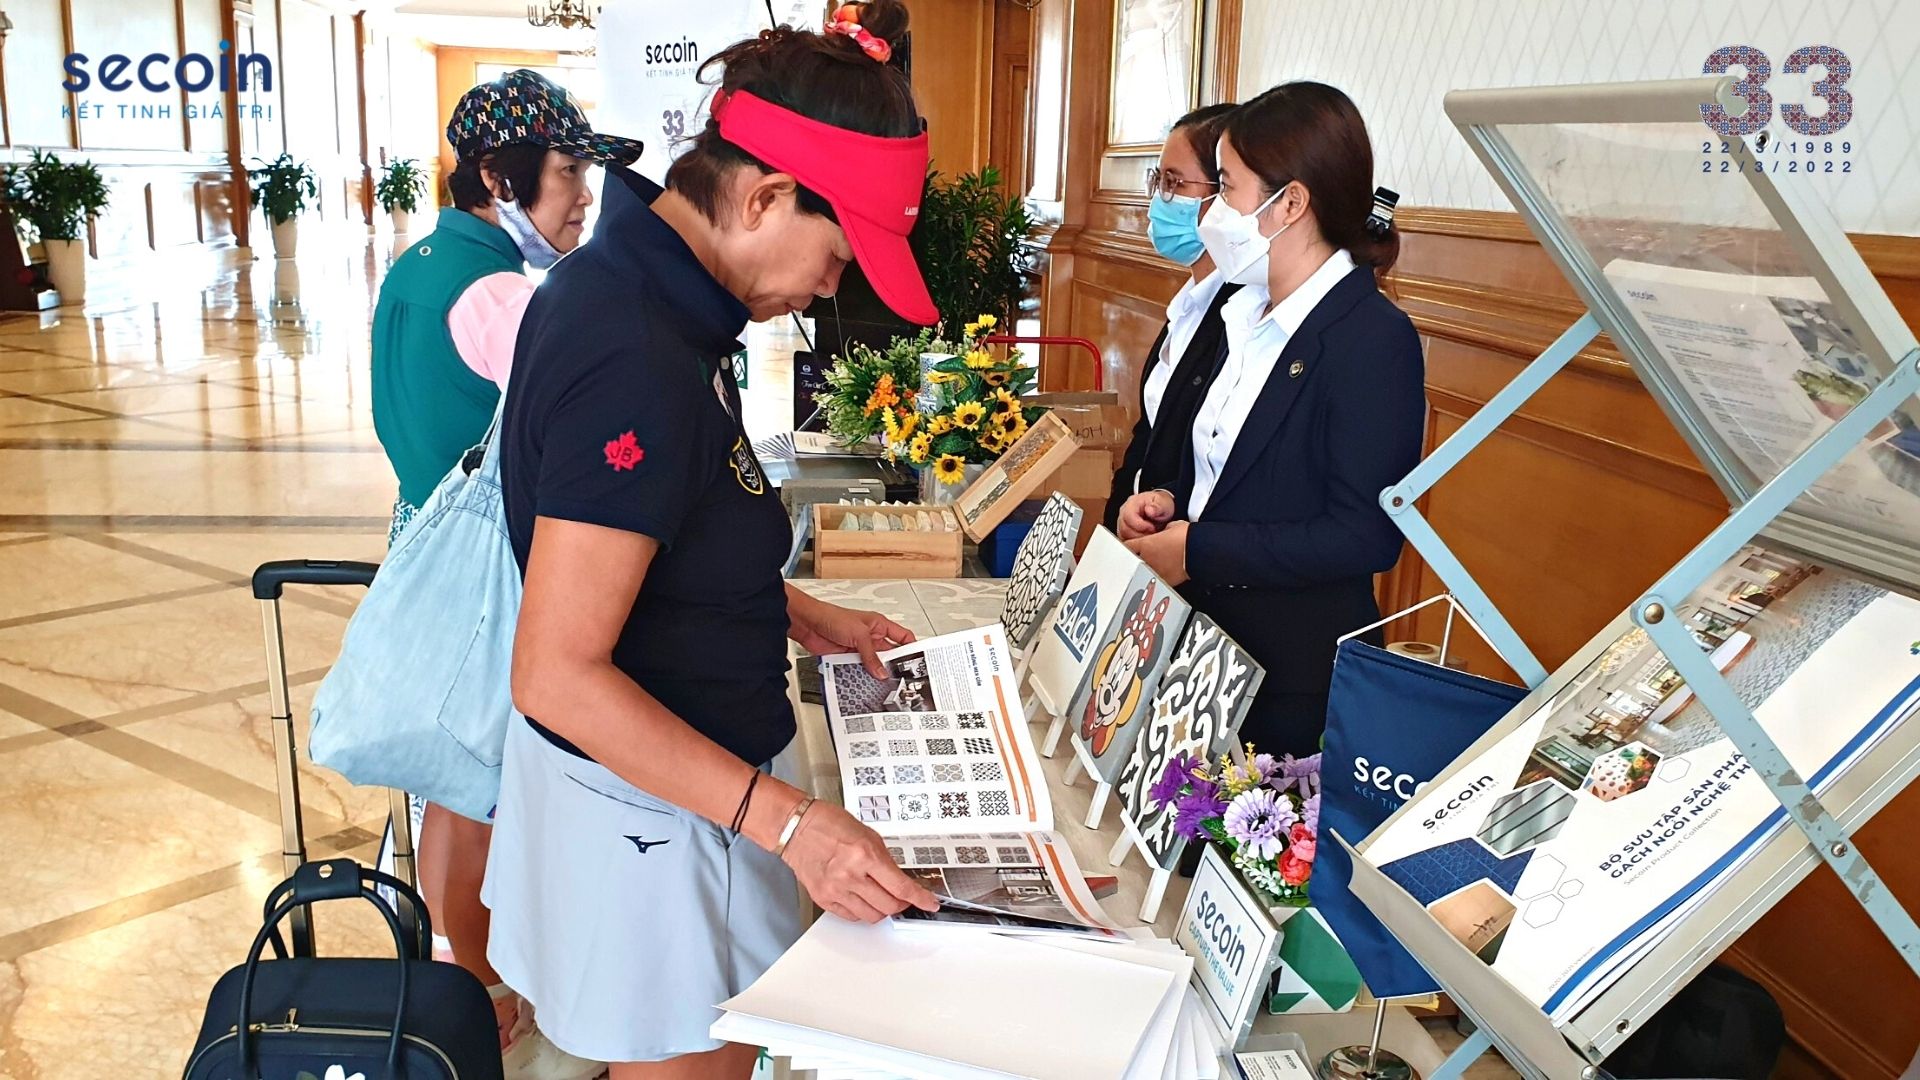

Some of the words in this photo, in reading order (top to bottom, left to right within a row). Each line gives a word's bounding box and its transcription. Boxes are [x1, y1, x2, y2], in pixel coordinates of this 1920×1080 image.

[645, 35, 698, 64] secoin
[662, 109, 685, 136] 33
[988, 647, 1001, 672] secoin
[1058, 598, 1095, 656] SACA
[1422, 776, 1494, 830] secoin
[1599, 853, 1622, 872] BỘ
[1623, 829, 1653, 854] SƯU
[1653, 805, 1682, 828] TẬP
[1683, 779, 1715, 805] SẢN
[1611, 847, 1653, 879] GẠCH
[1690, 781, 1731, 816] NGHỆ
[1623, 864, 1652, 886] Secoin
[1651, 840, 1684, 866] Product
[1683, 807, 1723, 841] Collection
[1188, 920, 1211, 959] CAPTURE
[1217, 968, 1235, 997] VALUE
[1196, 890, 1246, 977] secoin
